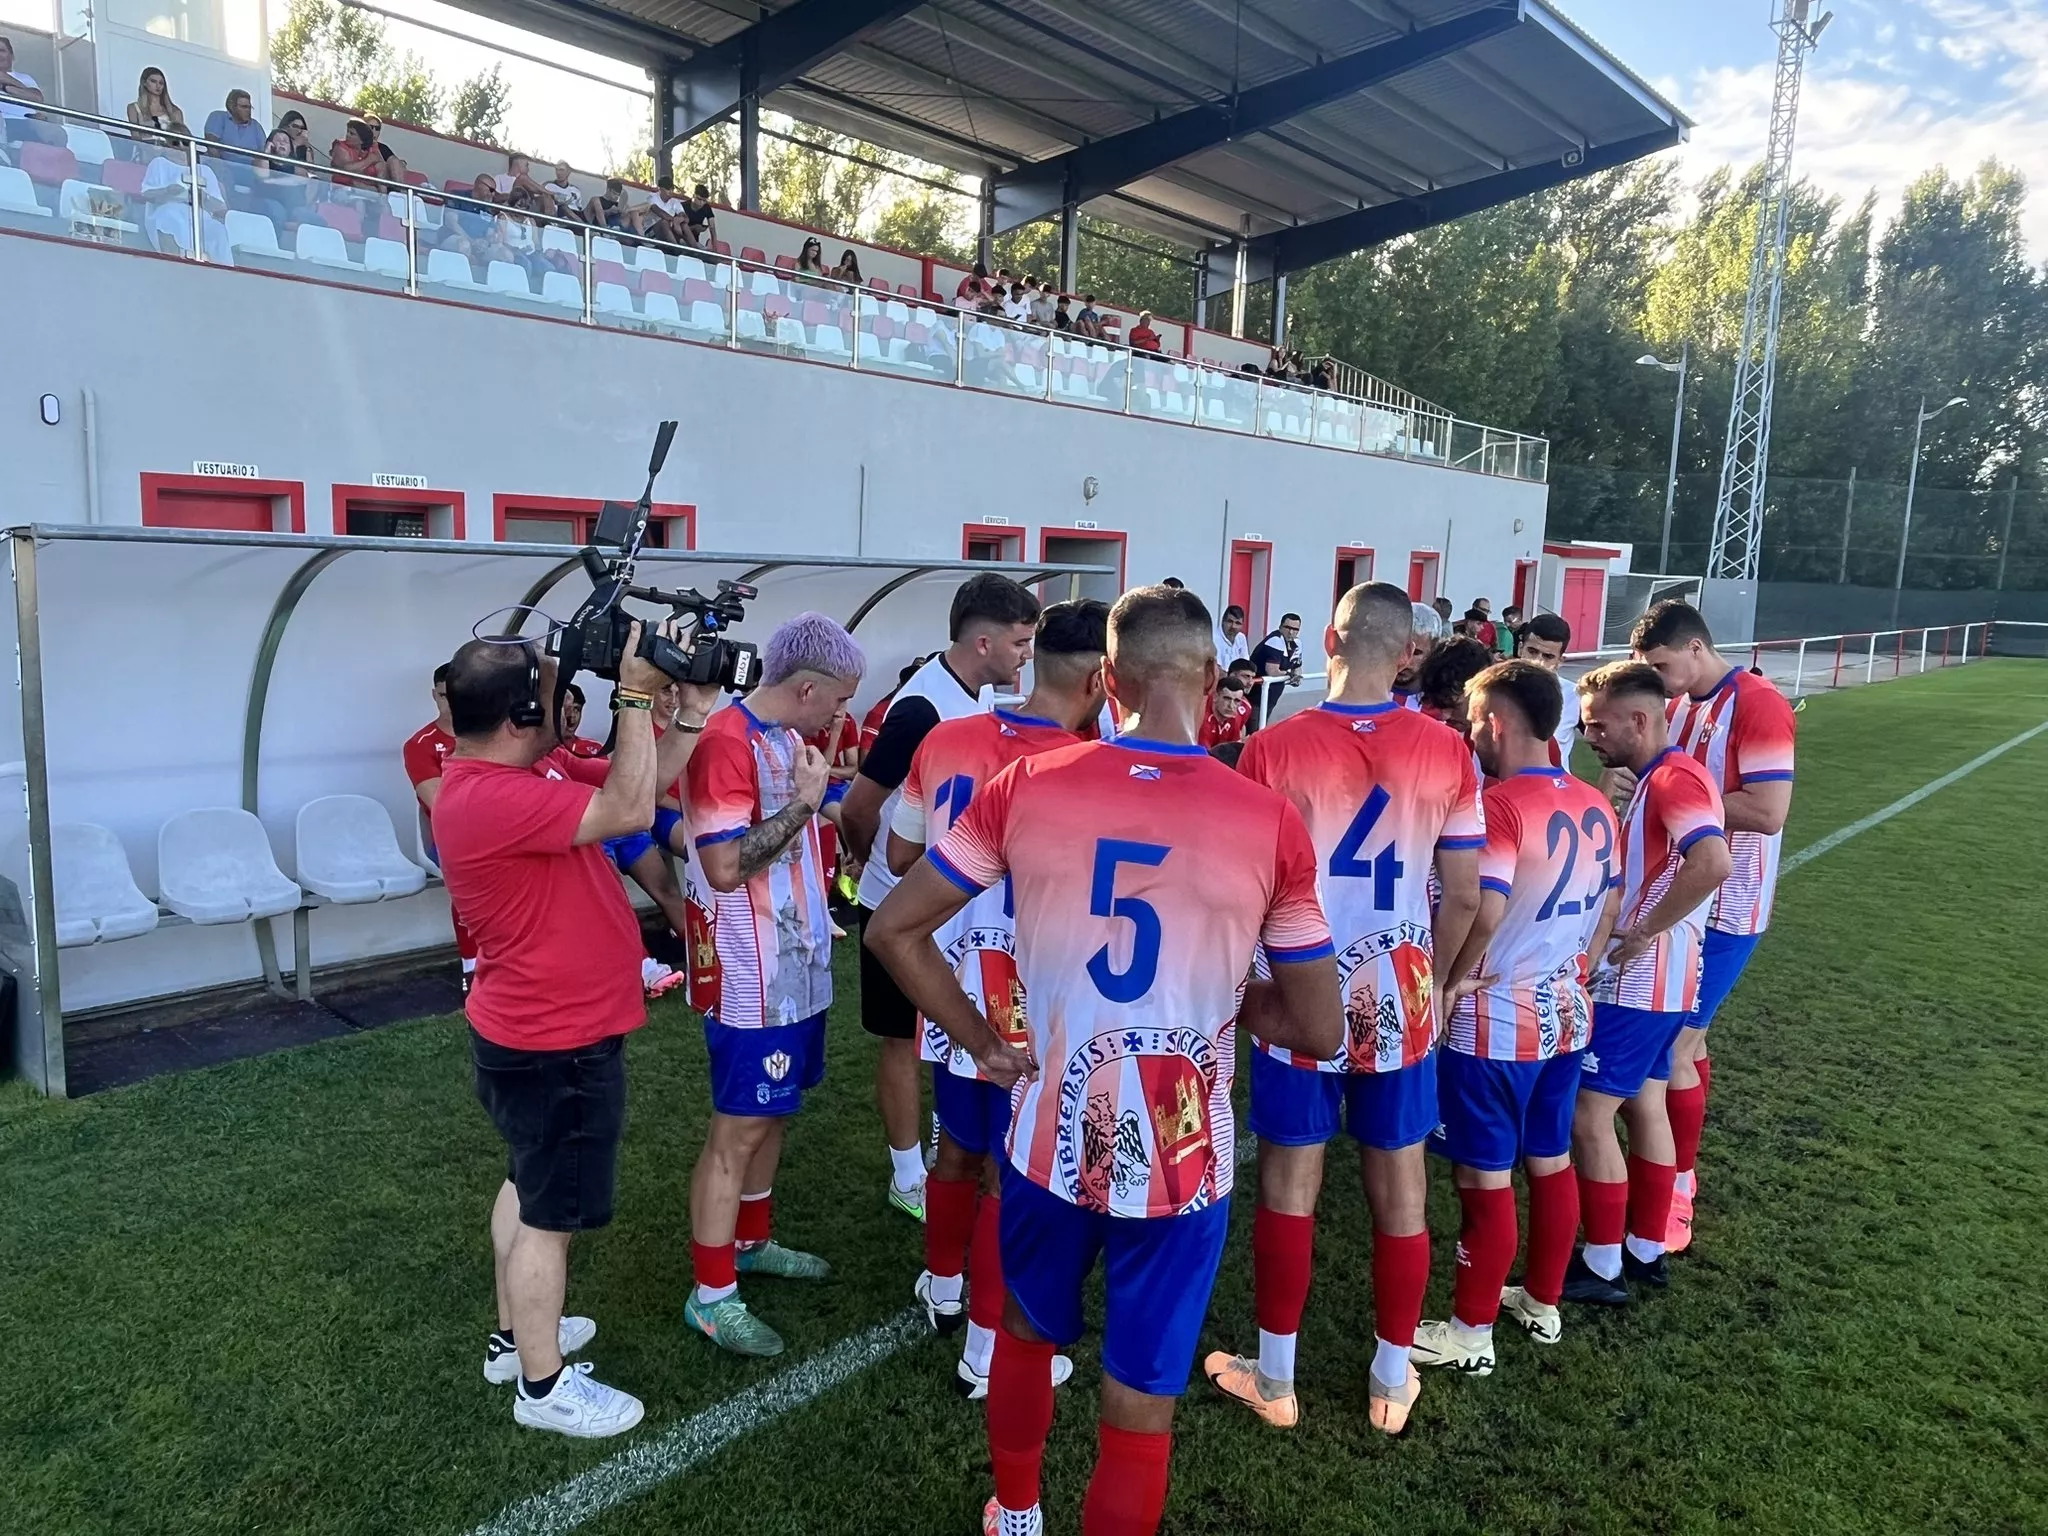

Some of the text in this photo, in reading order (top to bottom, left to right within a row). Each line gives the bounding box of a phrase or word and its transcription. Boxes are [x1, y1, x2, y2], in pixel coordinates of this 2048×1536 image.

[197, 463, 256, 477] VESTUARIO 2
[375, 474, 425, 487] VESTUARIO 1
[574, 604, 595, 630] SONY
[1329, 783, 1404, 911] 4
[1535, 806, 1612, 922] 23
[1086, 838, 1173, 1003] 5
